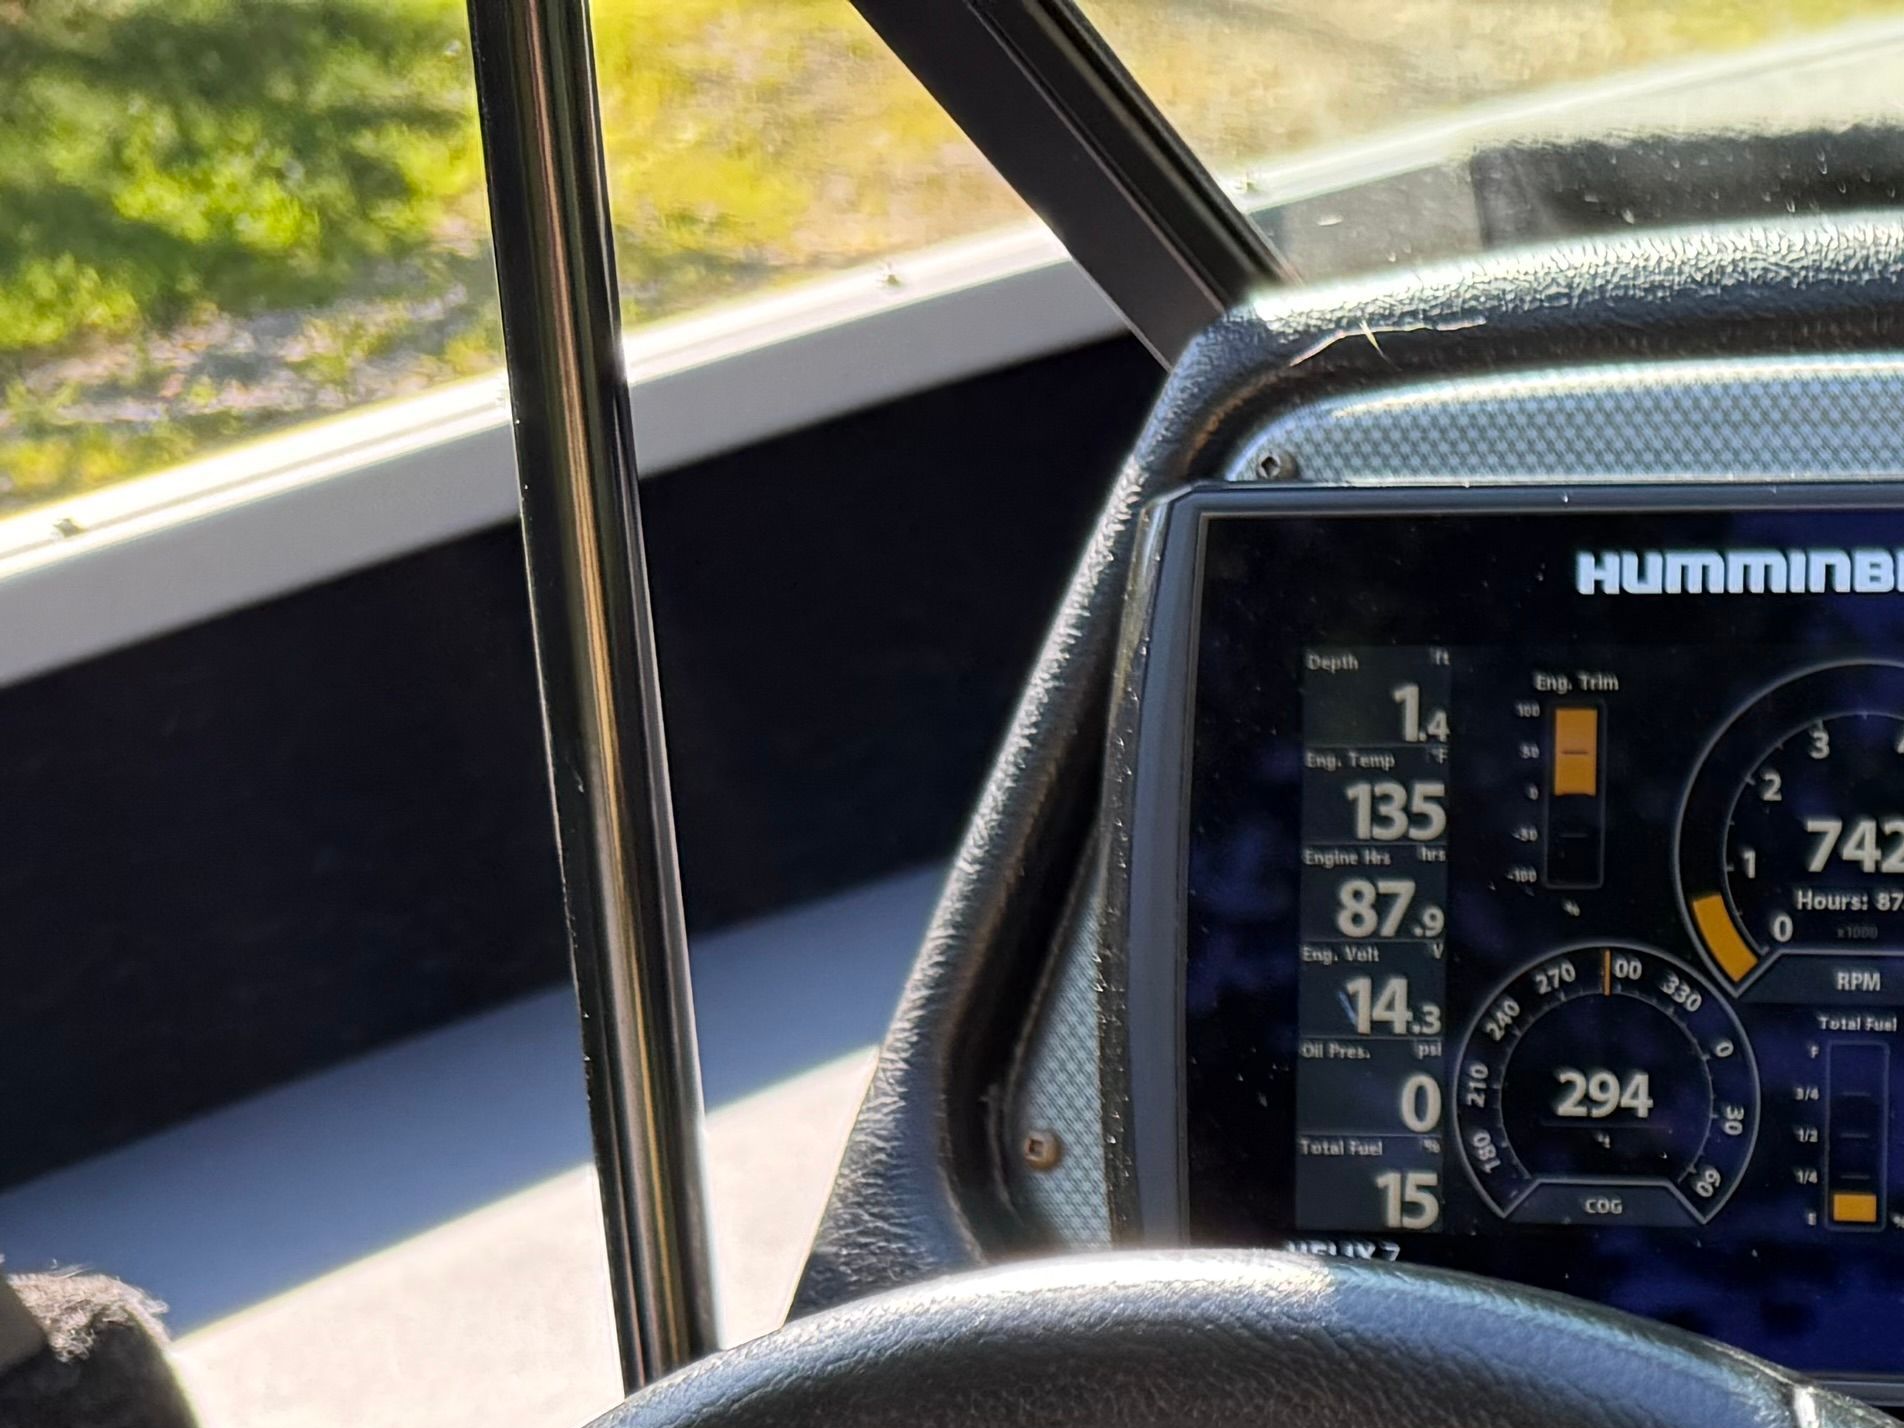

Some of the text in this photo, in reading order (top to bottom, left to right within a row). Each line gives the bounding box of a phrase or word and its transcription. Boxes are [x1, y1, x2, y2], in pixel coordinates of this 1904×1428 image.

[1306, 653, 1359, 673] Depth
[1534, 672, 1620, 694] Eng. Trim
[1393, 683, 1449, 742] 1.4
[1517, 703, 1540, 718] 100
[1810, 728, 1830, 759] 3
[1305, 751, 1343, 771] Eng.
[1349, 751, 1395, 771] Temp
[1761, 771, 1782, 801] 2
[1346, 781, 1447, 841] 135
[1303, 846, 1446, 869] Engine Hrs hrs
[1744, 849, 1756, 879] 1
[1337, 878, 1446, 938] 87.9
[1797, 889, 1868, 912] Hours:
[1771, 916, 1794, 942] 0
[1302, 943, 1443, 965] Eng. Volt V
[1535, 963, 1576, 995] 270
[1660, 974, 1702, 1012] 330
[1837, 971, 1881, 991] RPM
[1346, 975, 1442, 1035] 14.3
[1487, 1001, 1520, 1041] 240
[1816, 1015, 1897, 1032] Total Fuel
[1301, 1041, 1441, 1060] Oil Pres. psi
[1714, 1039, 1734, 1058] 0
[1467, 1063, 1489, 1108] 210
[1556, 1069, 1653, 1118] 294
[1400, 1073, 1442, 1133] 0
[1723, 1104, 1744, 1136] 30
[1301, 1139, 1345, 1156] Total
[1349, 1140, 1384, 1156] Fuel
[1472, 1131, 1501, 1173] 180
[1696, 1167, 1721, 1198] 60
[1375, 1172, 1439, 1230] 15
[1585, 1199, 1622, 1214] COG
